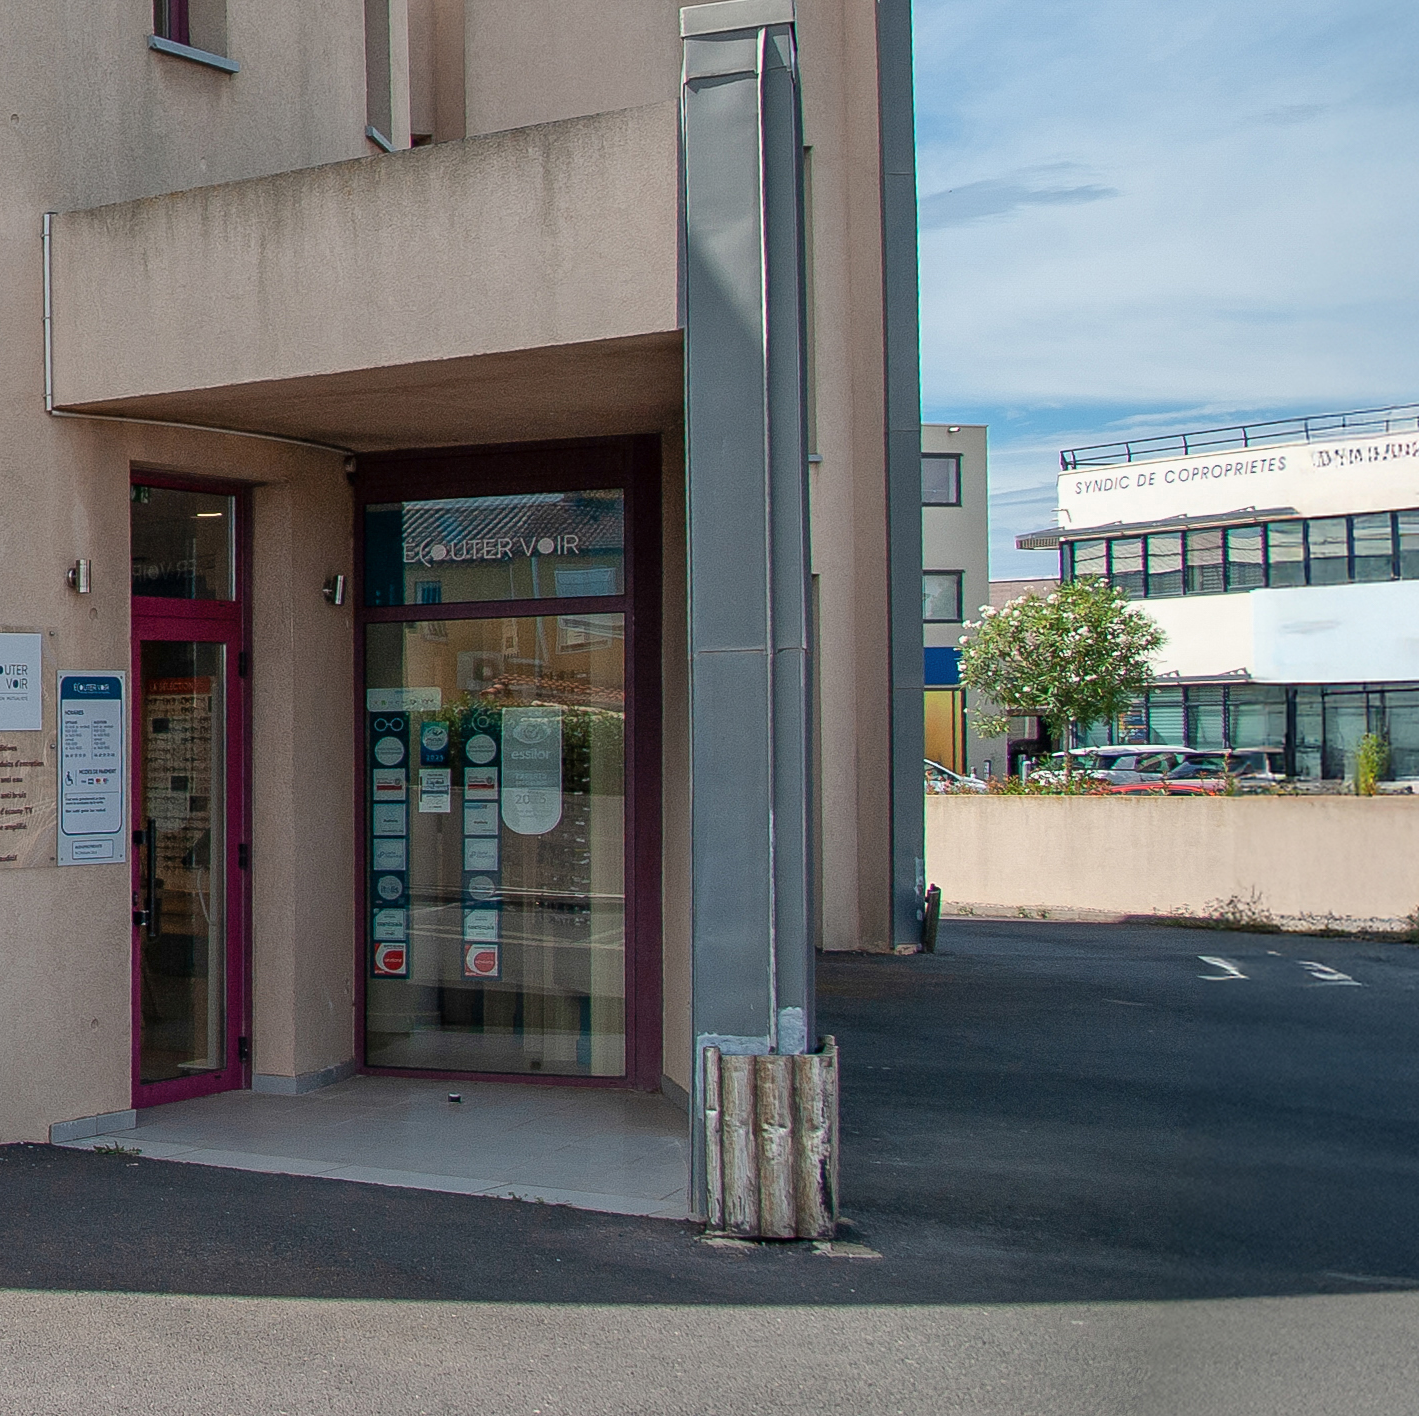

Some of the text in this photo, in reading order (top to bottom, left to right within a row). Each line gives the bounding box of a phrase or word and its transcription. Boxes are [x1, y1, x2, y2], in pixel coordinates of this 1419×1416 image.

[1074, 456, 1287, 495] SYNDIC DE COPROPRIETES
[403, 534, 580, 568] ÉCOUTER VOIR
[5, 678, 28, 690] VOIR
[511, 748, 551, 760] essilor
